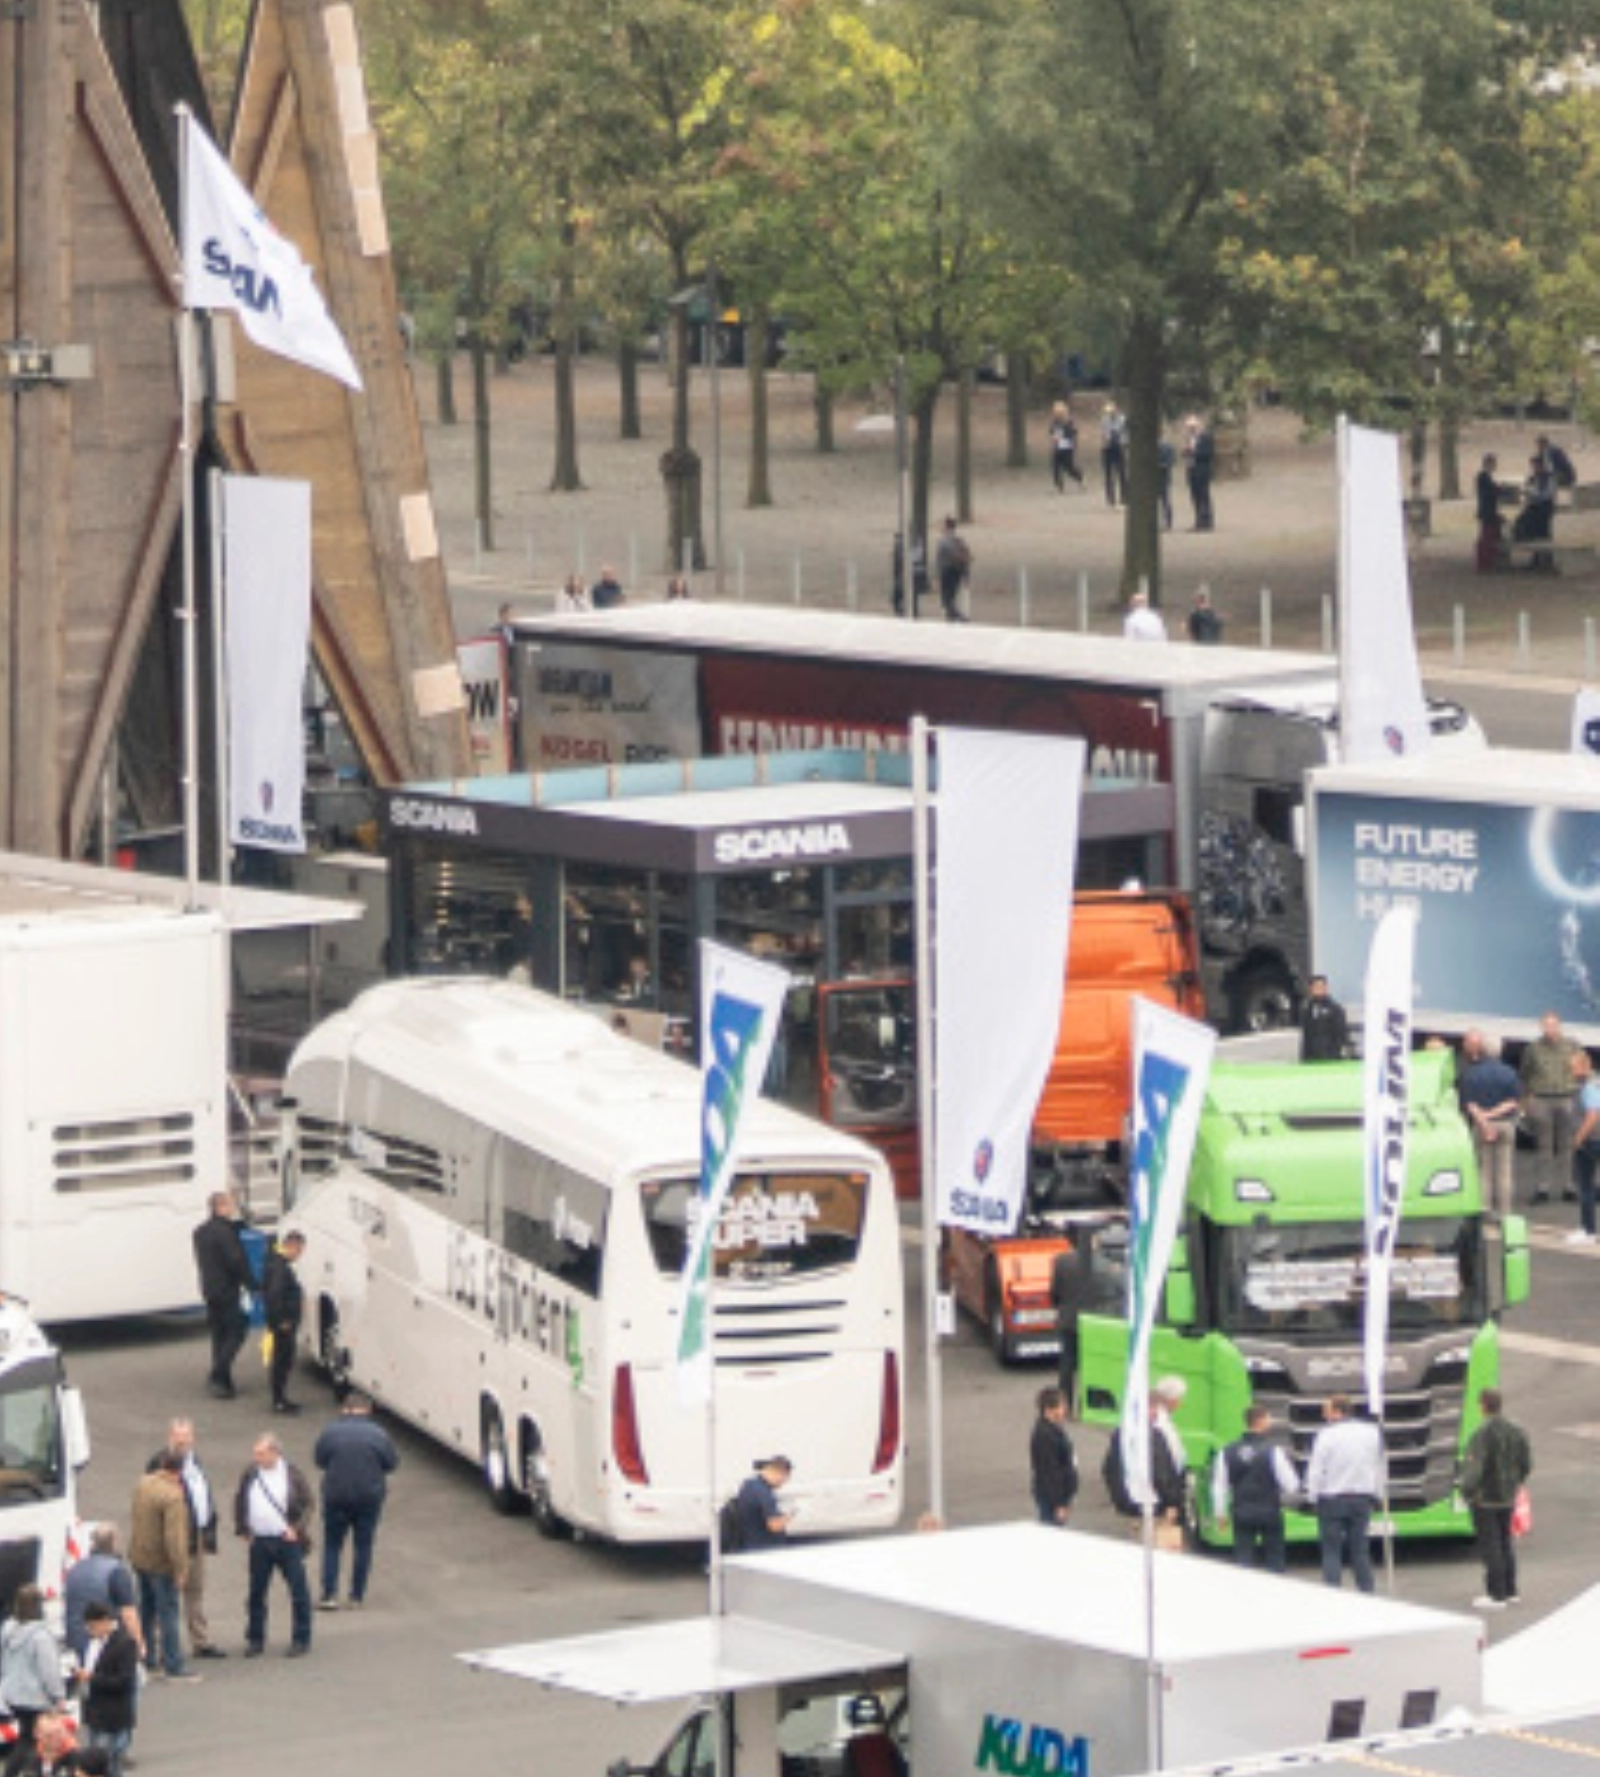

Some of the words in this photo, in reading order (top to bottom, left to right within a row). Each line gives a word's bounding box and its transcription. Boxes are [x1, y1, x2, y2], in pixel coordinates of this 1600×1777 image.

[390, 799, 479, 835] SCANIA
[714, 824, 851, 863] SCANIA
[1354, 823, 1479, 860] FUTURE
[1355, 856, 1480, 894] ENERGY
